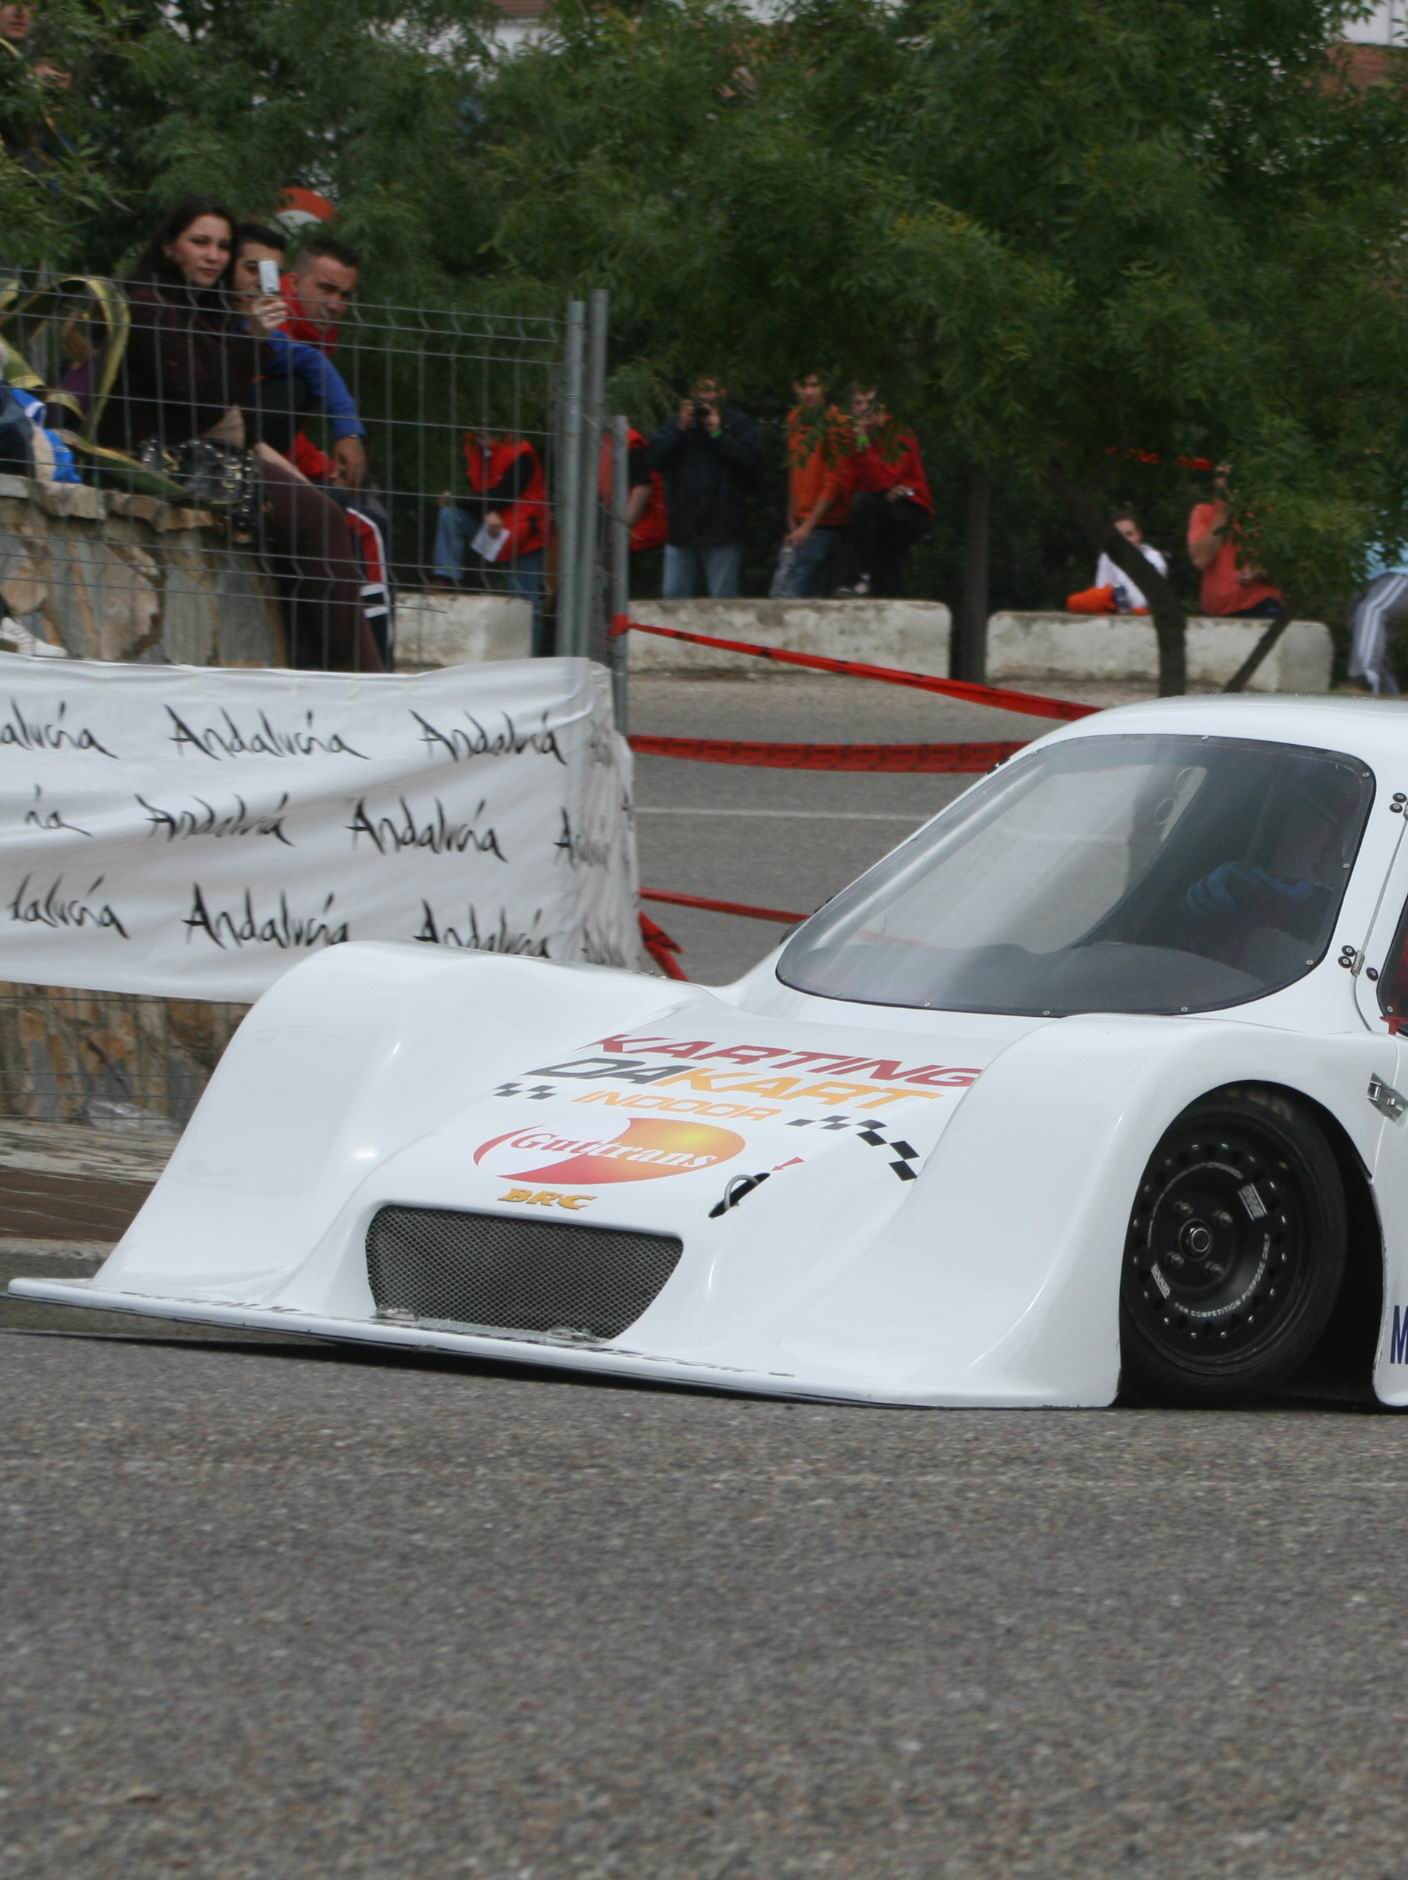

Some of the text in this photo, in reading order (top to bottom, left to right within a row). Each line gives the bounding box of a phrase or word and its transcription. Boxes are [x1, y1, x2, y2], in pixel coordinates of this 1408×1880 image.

[162, 703, 371, 761] Andalucía
[344, 797, 509, 864] Andalucía
[181, 881, 351, 950] Andalucía
[522, 1057, 946, 1110] DAKART
[574, 1033, 985, 1088] KARTING
[569, 1089, 782, 1121] INDOOR
[498, 1187, 597, 1210] BRC
